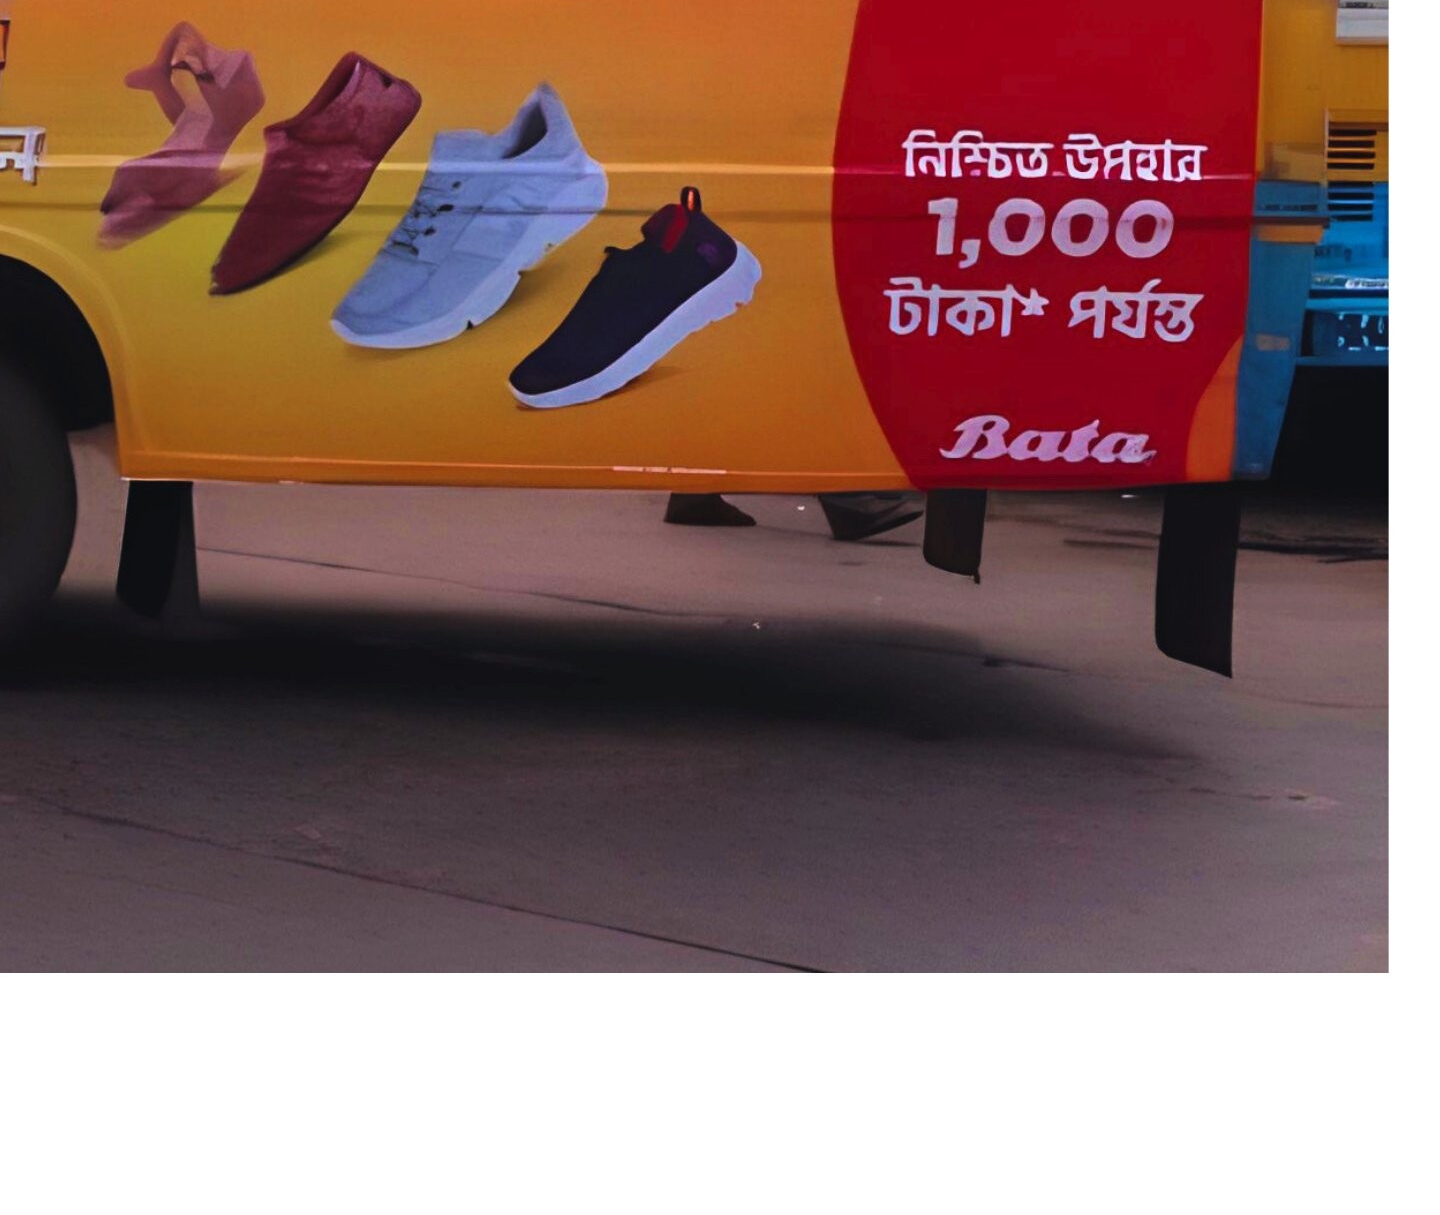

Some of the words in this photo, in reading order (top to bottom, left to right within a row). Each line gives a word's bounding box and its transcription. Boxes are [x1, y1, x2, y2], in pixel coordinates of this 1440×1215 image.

[902, 130, 1053, 178] নিশ্চিত
[1063, 134, 1207, 182] উপহার
[928, 198, 1173, 268] 1,000
[1068, 279, 1204, 342] পর্যন্ত
[940, 415, 1156, 463] Bata
